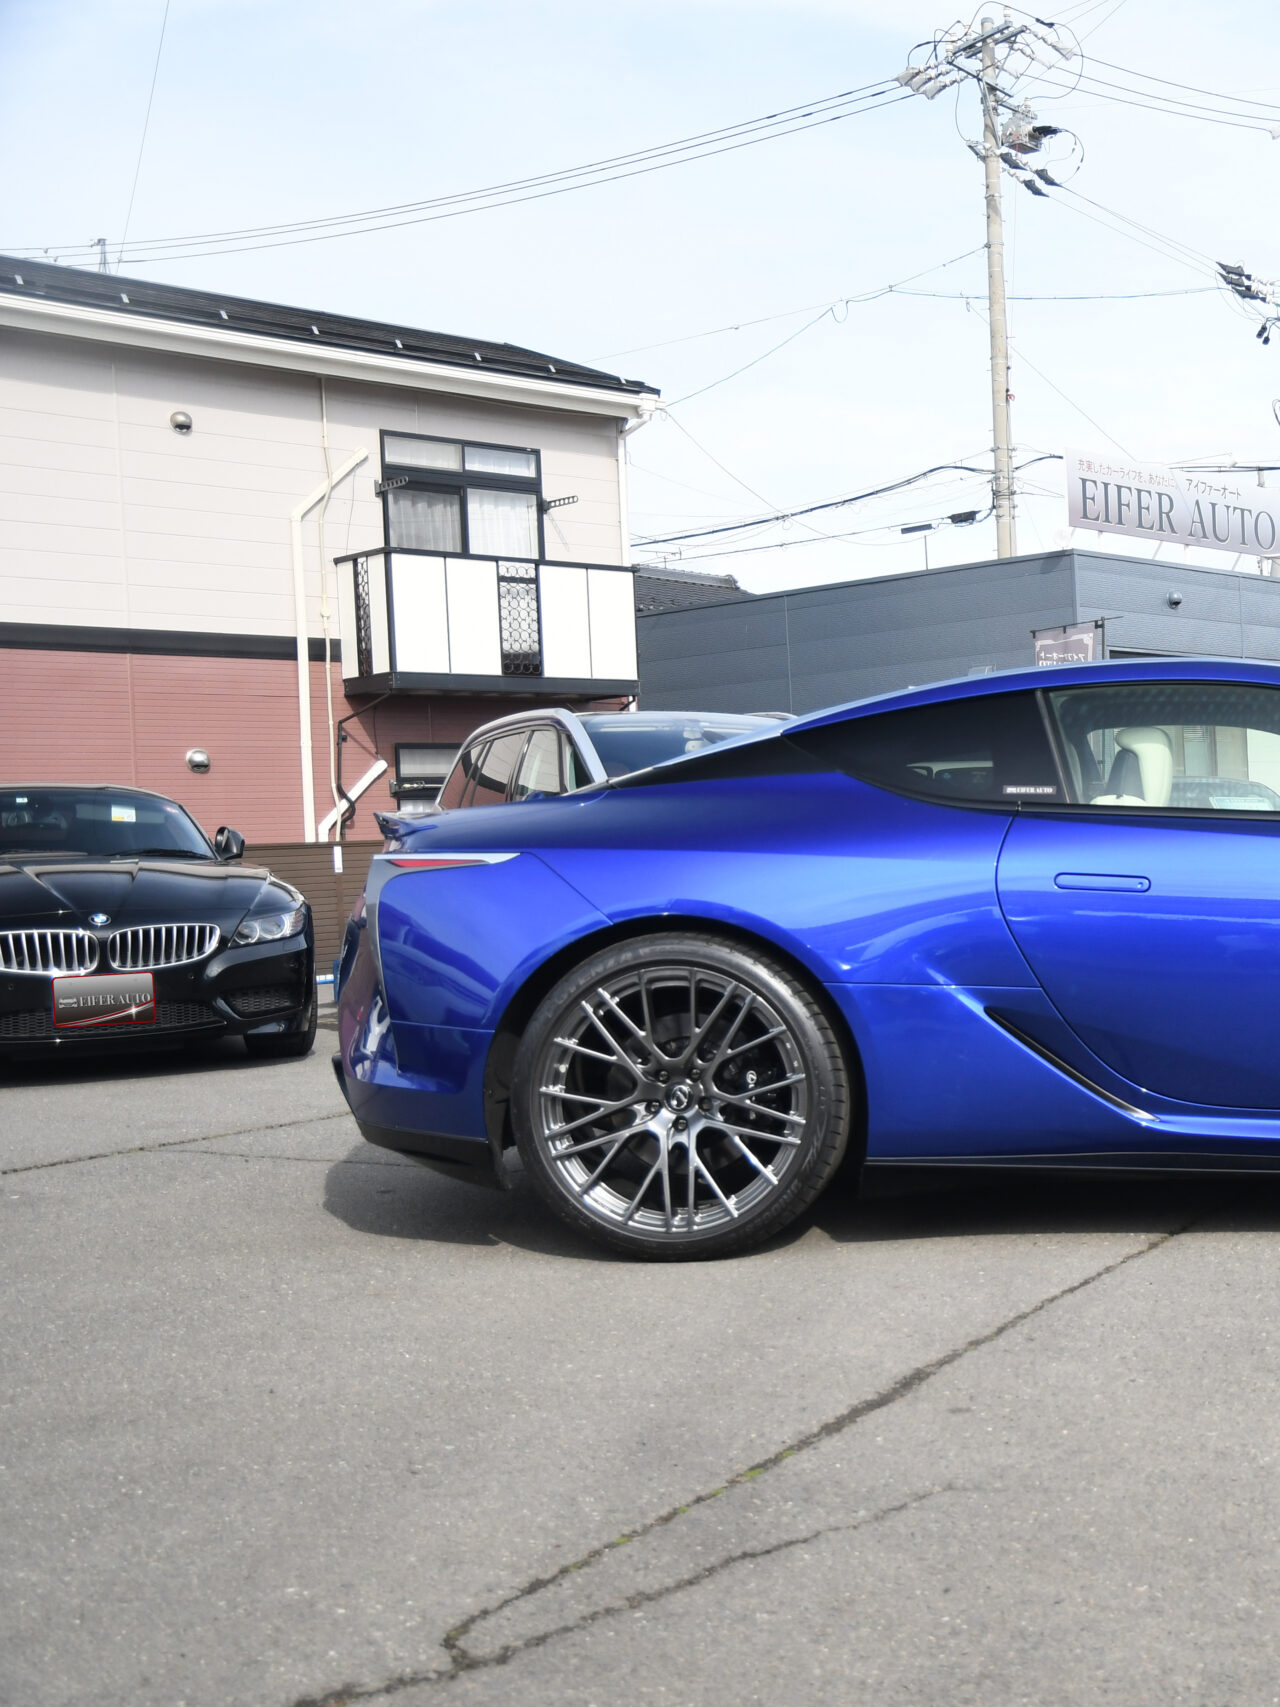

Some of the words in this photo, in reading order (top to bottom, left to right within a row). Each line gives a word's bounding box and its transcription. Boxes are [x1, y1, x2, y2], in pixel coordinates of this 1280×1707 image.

[1185, 478, 1242, 501] アイファーオート
[1078, 477, 1178, 535] EIFER
[1187, 498, 1276, 550] AUTO
[79, 994, 115, 1007] EIFER
[117, 992, 151, 1004] AUTO
